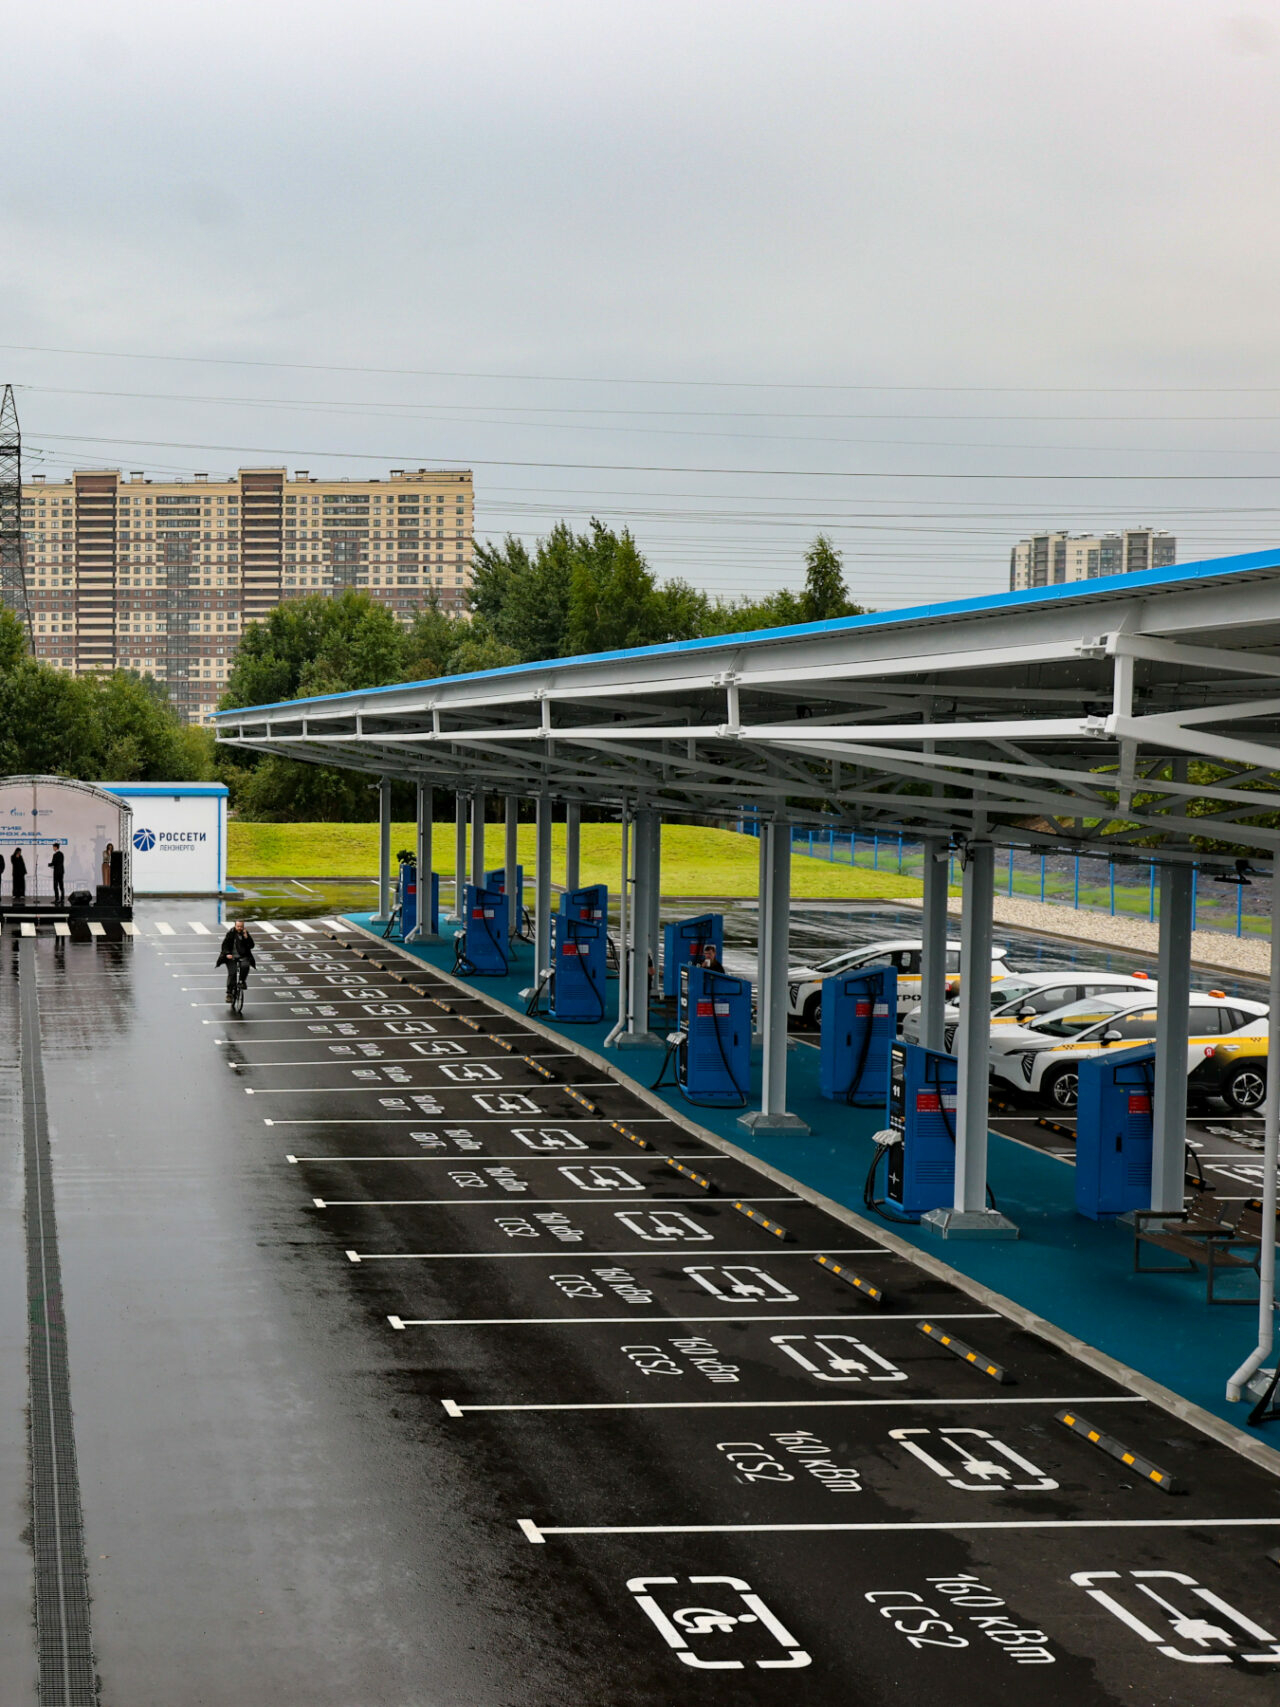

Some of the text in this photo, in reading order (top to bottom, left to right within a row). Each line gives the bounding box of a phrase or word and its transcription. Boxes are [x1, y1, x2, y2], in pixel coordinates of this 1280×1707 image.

[159, 832, 206, 842] РОССЕТИ
[892, 1084, 900, 1097] 11
[493, 1217, 541, 1238] CCS2
[532, 1211, 571, 1224] 160
[591, 1267, 636, 1282] 160
[548, 1274, 604, 1298] CCS2
[668, 1336, 719, 1355] 160
[620, 1345, 684, 1375] CCS2
[769, 1430, 832, 1454] 160
[716, 1442, 795, 1482] CCS2
[925, 1573, 1006, 1608] 160
[864, 1591, 970, 1649] CCS2
